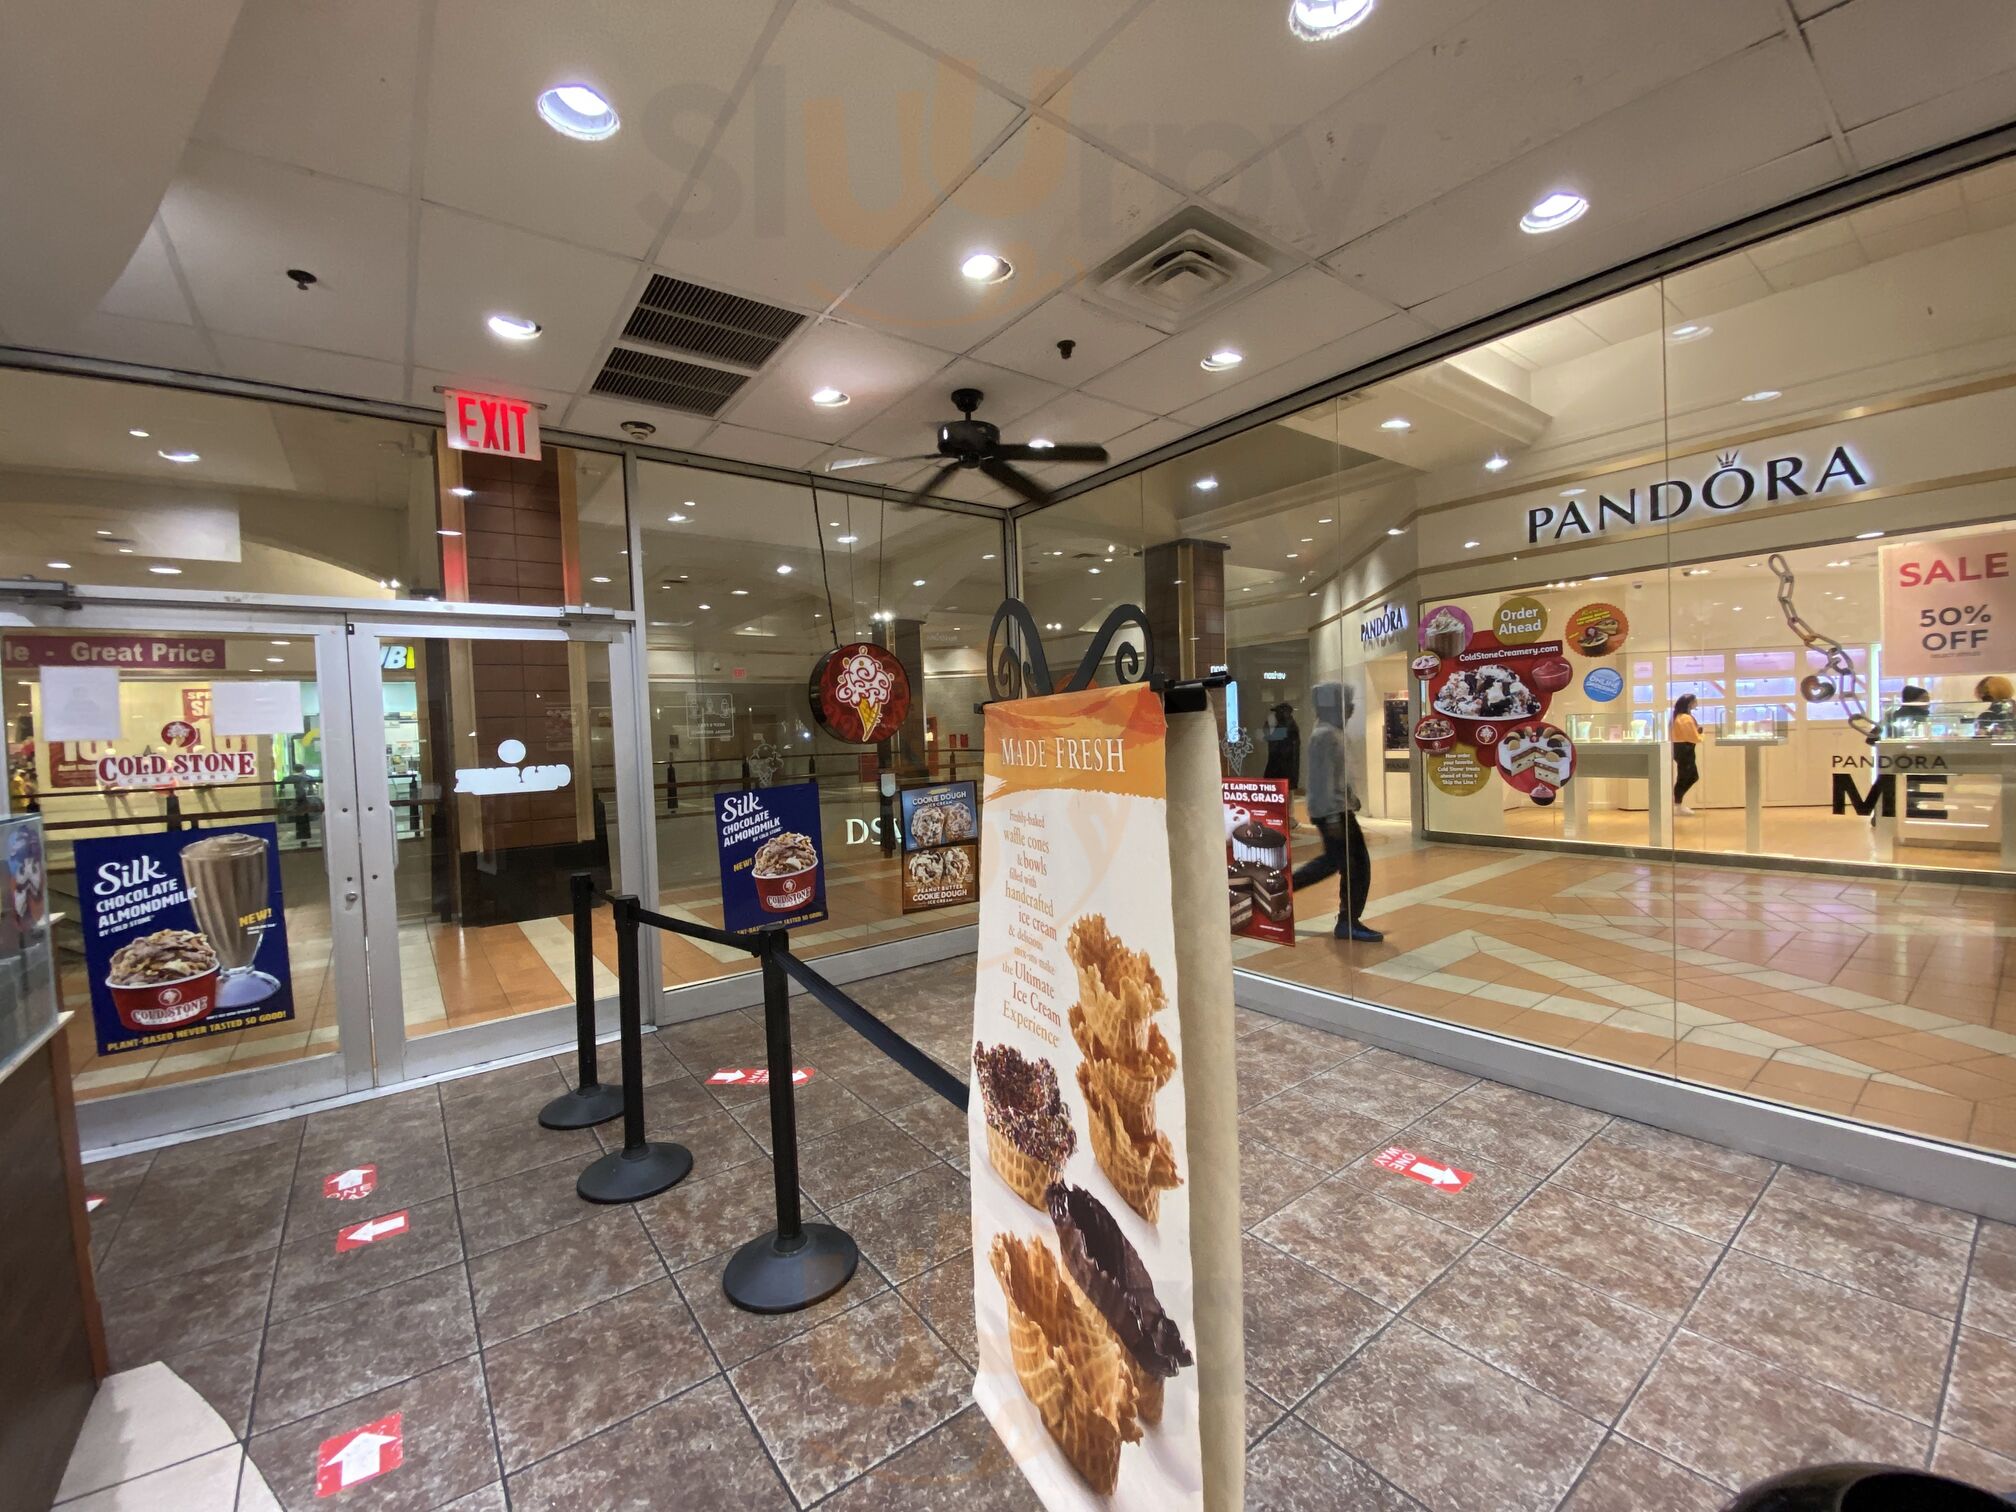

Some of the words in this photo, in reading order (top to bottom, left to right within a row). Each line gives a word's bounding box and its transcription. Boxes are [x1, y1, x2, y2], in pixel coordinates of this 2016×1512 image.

[458, 397, 526, 454] EXIT
[1528, 446, 1866, 543] PANDORA
[1899, 552, 2009, 587] SALE
[1361, 606, 1404, 641] PANDORA
[1500, 607, 1539, 622] Order
[1920, 605, 1992, 628] 50%
[1498, 620, 1542, 636] Ahead
[1922, 629, 1989, 651] OFF
[71, 642, 144, 662] Great
[151, 643, 215, 663] Price
[1459, 644, 1559, 662] ColdStoneCreamery.com
[99, 757, 167, 782] COLD
[174, 752, 256, 776] STONE
[1001, 738, 1047, 768] MADE
[1055, 737, 1126, 773] FRESH
[1832, 754, 1948, 769] PANDORA
[127, 773, 230, 785] CREAMERY
[1230, 783, 1259, 791] EARNED
[721, 792, 764, 823] Silk
[912, 795, 940, 806] COOKIE
[940, 791, 967, 801] DOUGH
[1223, 792, 1250, 803] DADS,
[1251, 793, 1285, 804] GRADS
[1832, 773, 1948, 819] ME
[722, 810, 770, 836] CHOCOLATE
[1009, 809, 1045, 829] Freshly-baked
[723, 817, 781, 847] ALMONDMILK
[1003, 826, 1026, 847] waffle
[1027, 836, 1050, 854] cones
[93, 855, 167, 895] Silk
[733, 857, 752, 872] NEW!
[1022, 852, 1048, 876] bowls
[1009, 867, 1023, 884] filled
[1023, 875, 1037, 889] with
[96, 879, 178, 913] CHOCOLATE
[98, 887, 198, 928] ALMONDMILK
[912, 892, 940, 901] COOKIE
[940, 889, 968, 898] DOUGH
[1005, 880, 1055, 917] handcrafted
[239, 908, 272, 927] NEW!
[1018, 905, 1030, 927] ice
[1032, 917, 1057, 942] cream
[1008, 925, 1015, 937] &
[1017, 928, 1044, 951] delicious
[1013, 946, 1038, 966] mix-ins
[1002, 960, 1014, 975] the
[1014, 960, 1055, 999] Ultimate
[166, 997, 208, 1017] STONE
[1012, 982, 1027, 1004] Ice
[1030, 991, 1061, 1028] Cream
[107, 1032, 174, 1051] PLANT-BASED
[176, 1026, 207, 1038] NEVER
[209, 1019, 243, 1032] TASTED
[245, 1016, 257, 1025] SO
[259, 1010, 286, 1022] GOOD!
[1003, 1000, 1060, 1048] Experience
[1374, 1146, 1404, 1167] WAY
[1388, 1152, 1417, 1171] ONE
